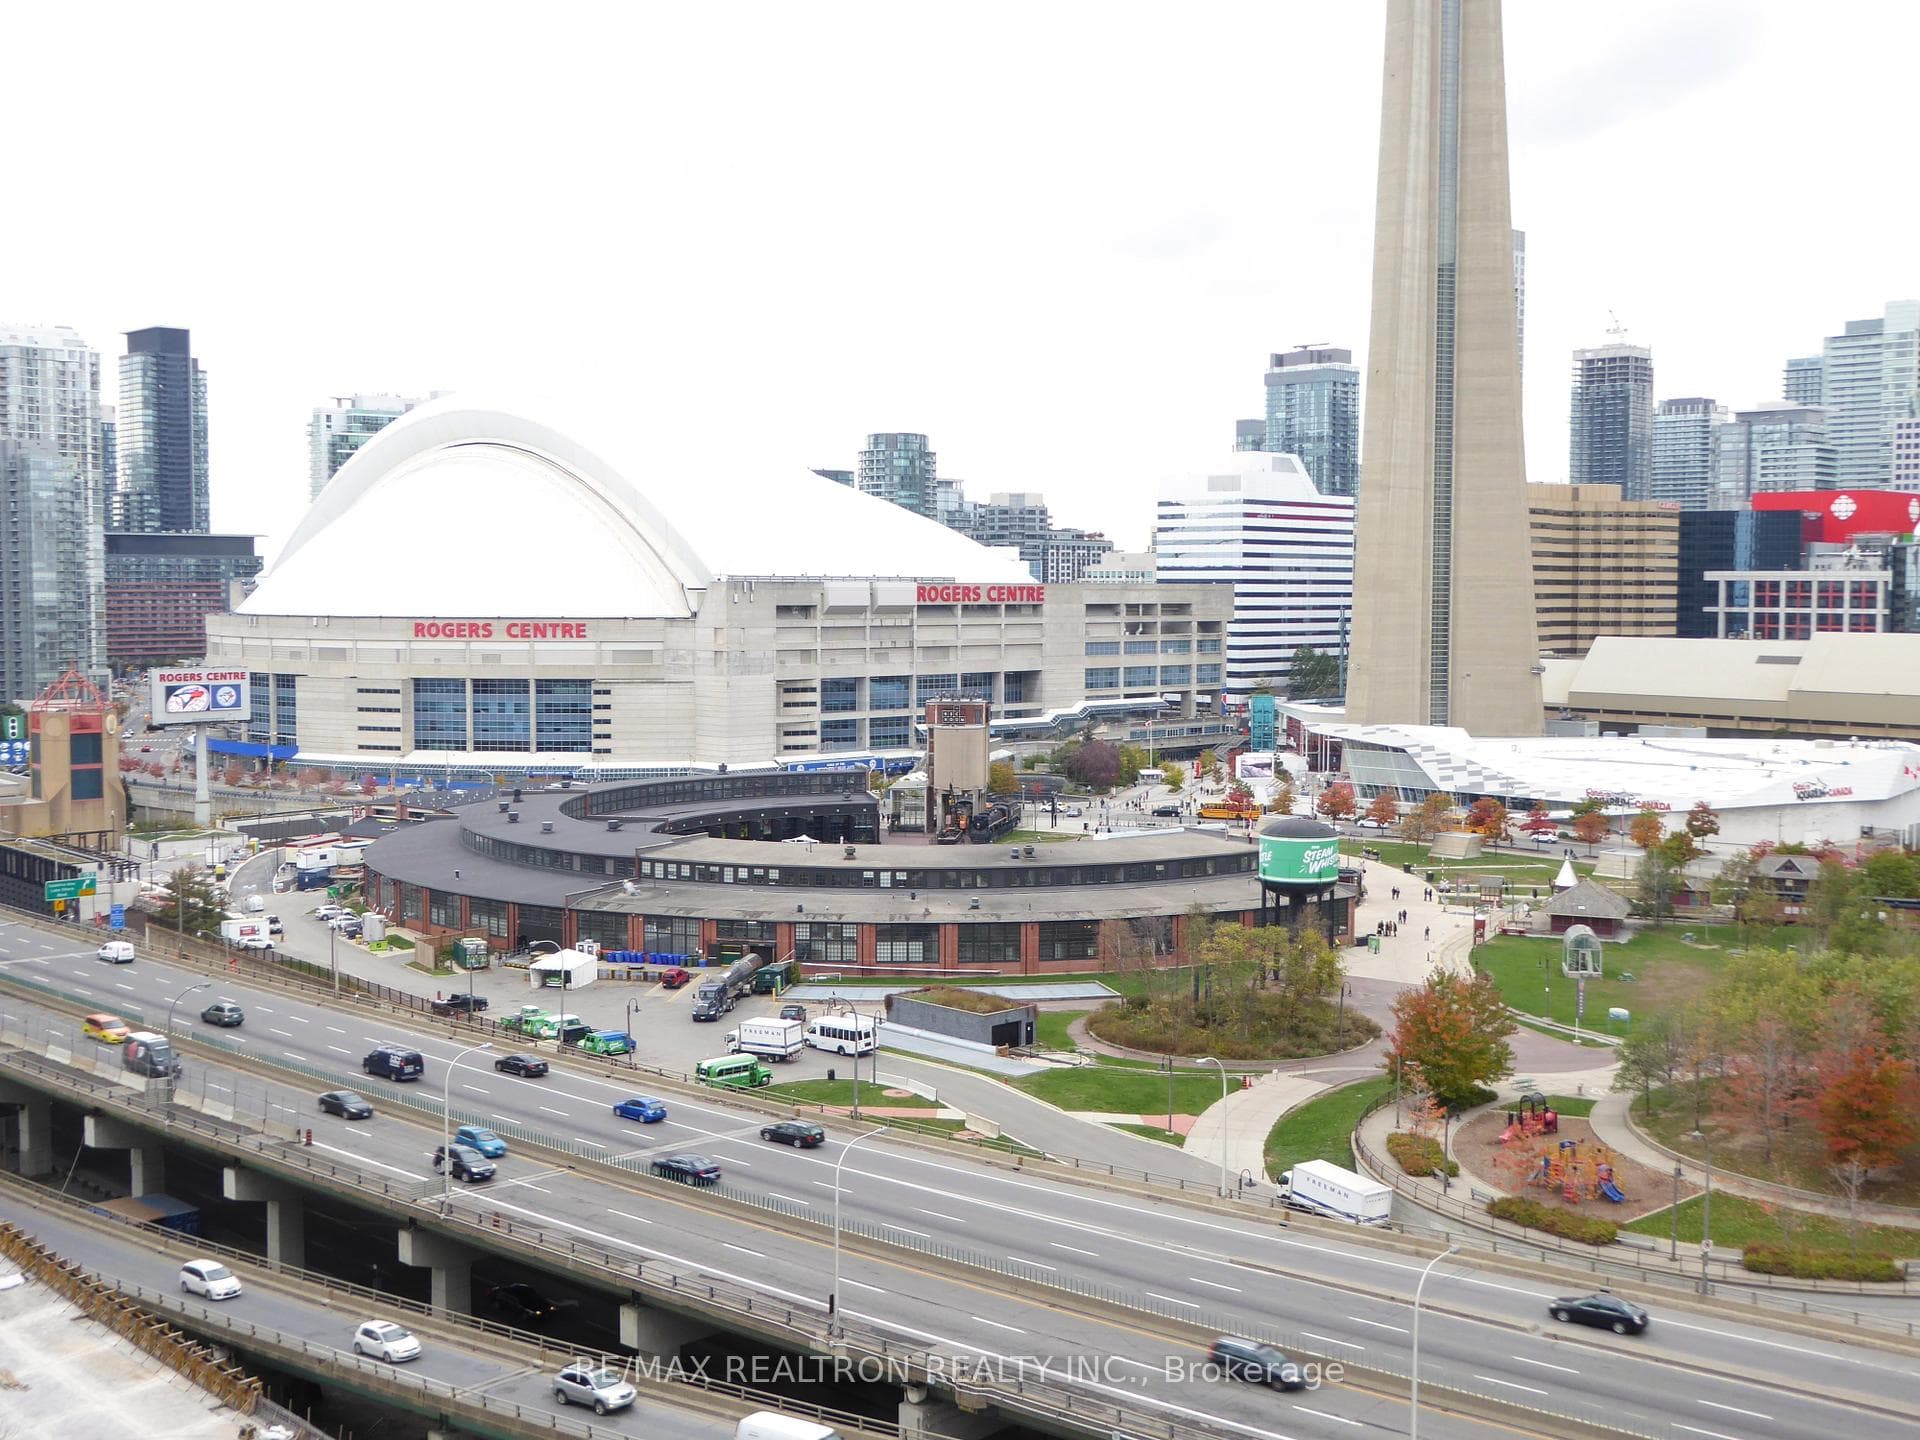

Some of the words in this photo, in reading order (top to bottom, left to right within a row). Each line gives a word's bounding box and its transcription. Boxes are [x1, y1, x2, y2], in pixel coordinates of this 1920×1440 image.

[917, 586, 981, 602] ROGERS
[986, 586, 1045, 602] CENTRE
[414, 622, 493, 638] ROGERS
[506, 622, 587, 638] CENTRE
[159, 672, 202, 682] ROGERS
[206, 671, 246, 681] CENTRE
[1634, 799, 1672, 811] CANADA
[1303, 845, 1334, 863] STEAM
[743, 1028, 781, 1037] FREEMAN
[1306, 1176, 1349, 1199] FREEMAN
